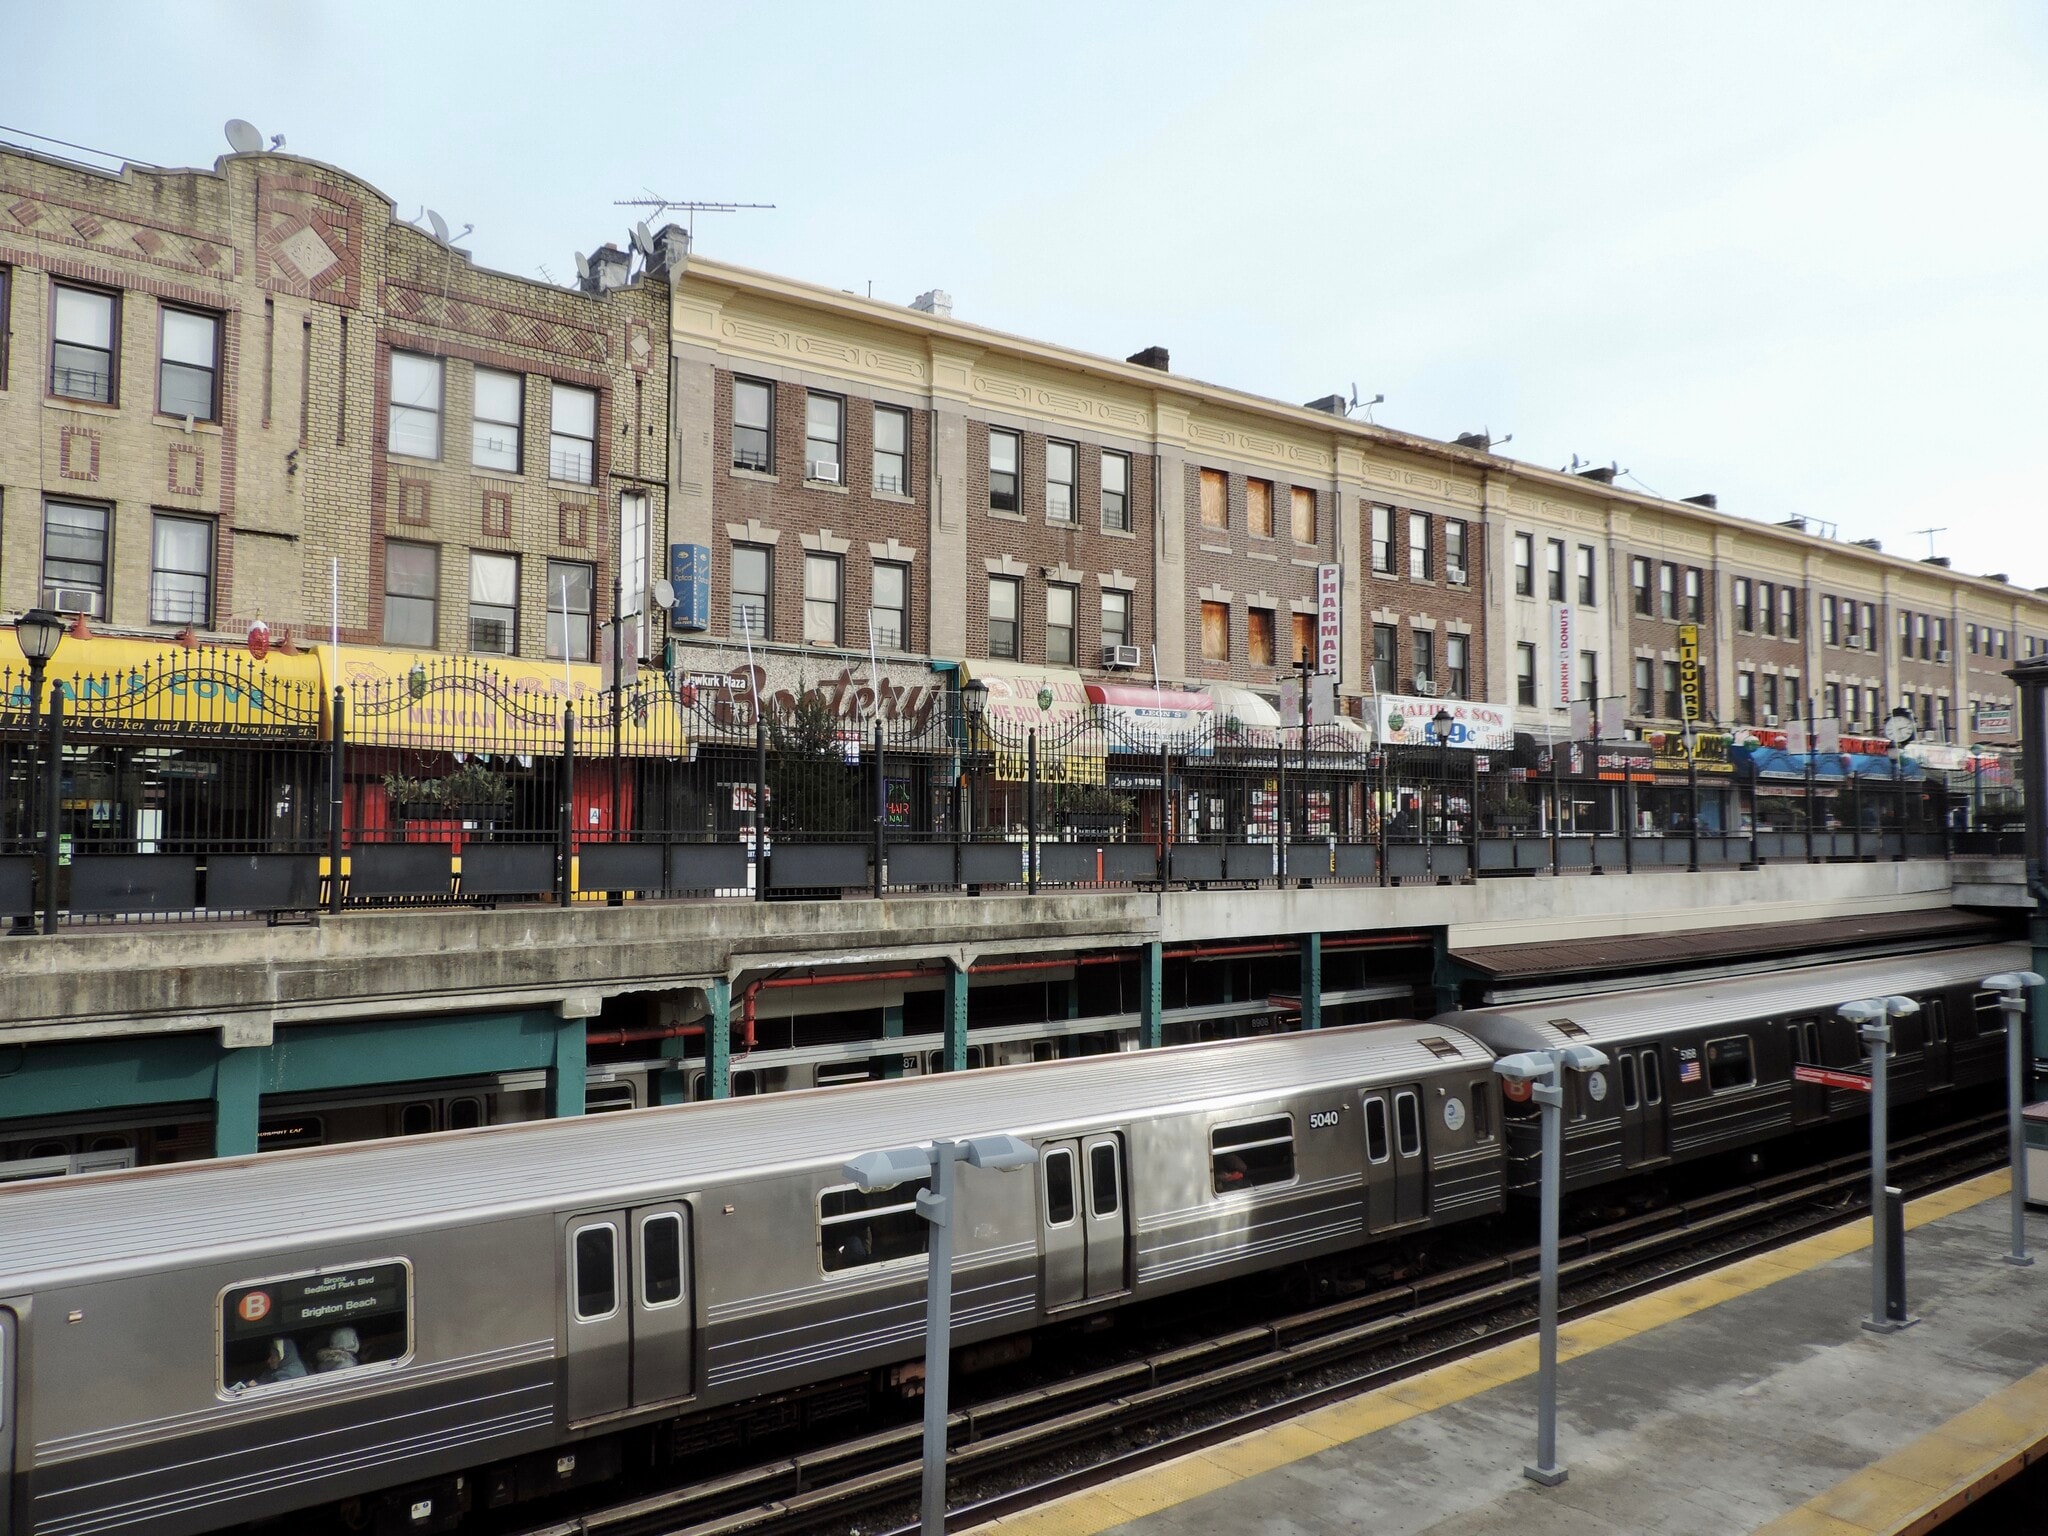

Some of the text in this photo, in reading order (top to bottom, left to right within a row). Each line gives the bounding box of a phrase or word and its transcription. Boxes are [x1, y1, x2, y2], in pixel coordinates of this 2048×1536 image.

[1560, 608, 1569, 703] DUNKIN' DONUTS
[683, 674, 746, 689] ewkirk Plaza
[1681, 637, 1698, 716] LIQUORS
[408, 707, 496, 732] MEXICAN
[1014, 706, 1042, 723] BUY
[1047, 709, 1057, 724] &
[1141, 709, 1182, 718] LEON'S
[1454, 706, 1468, 719] &
[62, 716, 85, 729] erk
[153, 719, 180, 732] and
[1310, 1111, 1339, 1128] 5040
[304, 1276, 375, 1295] Bedford Park Blvd
[323, 1276, 347, 1285] Bronx
[245, 1295, 266, 1318] B
[301, 1297, 377, 1318] Brighton Beach
